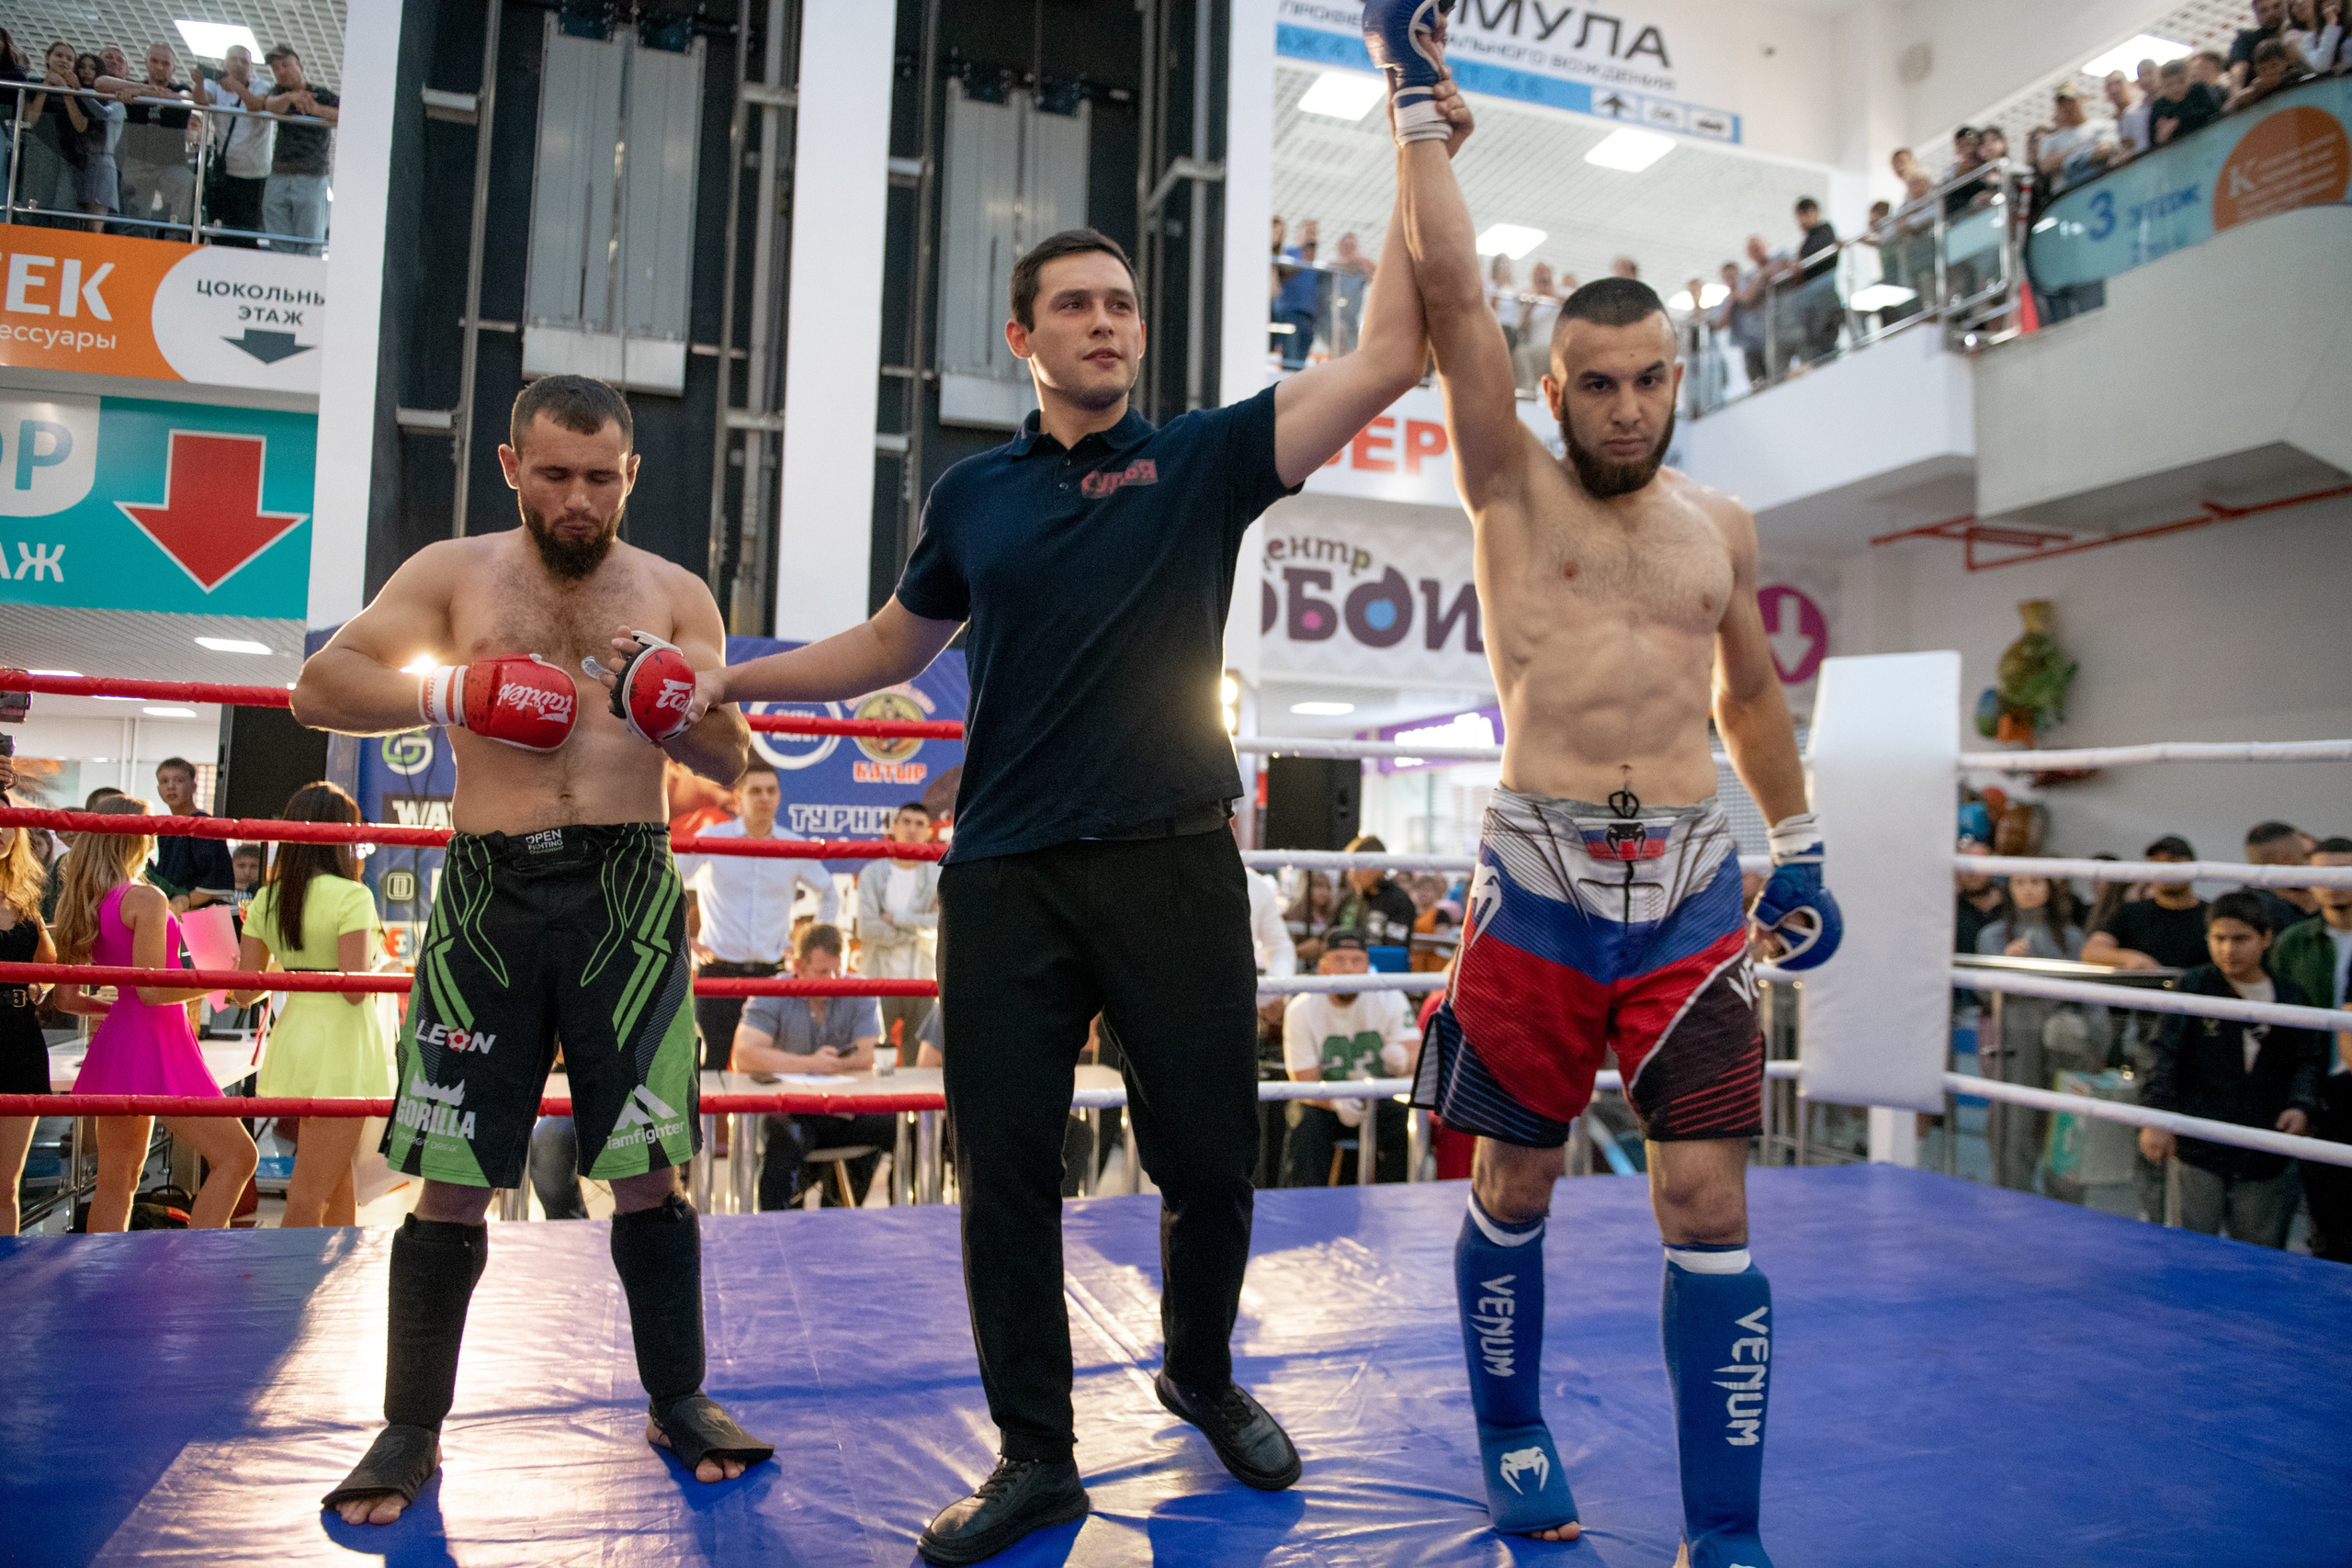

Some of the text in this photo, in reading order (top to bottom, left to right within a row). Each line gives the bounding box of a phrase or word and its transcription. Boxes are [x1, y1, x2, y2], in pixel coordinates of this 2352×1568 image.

[0, 252, 116, 321] ЕК
[238, 304, 304, 326] ЭТАЖ
[0, 419, 74, 491] Р
[1323, 415, 1448, 476] ЕР
[1263, 536, 1372, 576] ентр
[1262, 564, 1485, 653] БОИ
[497, 682, 573, 724] Fairtex
[526, 829, 562, 844] OPEN
[414, 1019, 497, 1055] LEON
[395, 1095, 476, 1140] GORILLA
[607, 1122, 684, 1149] iamfighter
[1471, 1274, 1517, 1378] VENUM
[1711, 1305, 1770, 1447] VENUM
